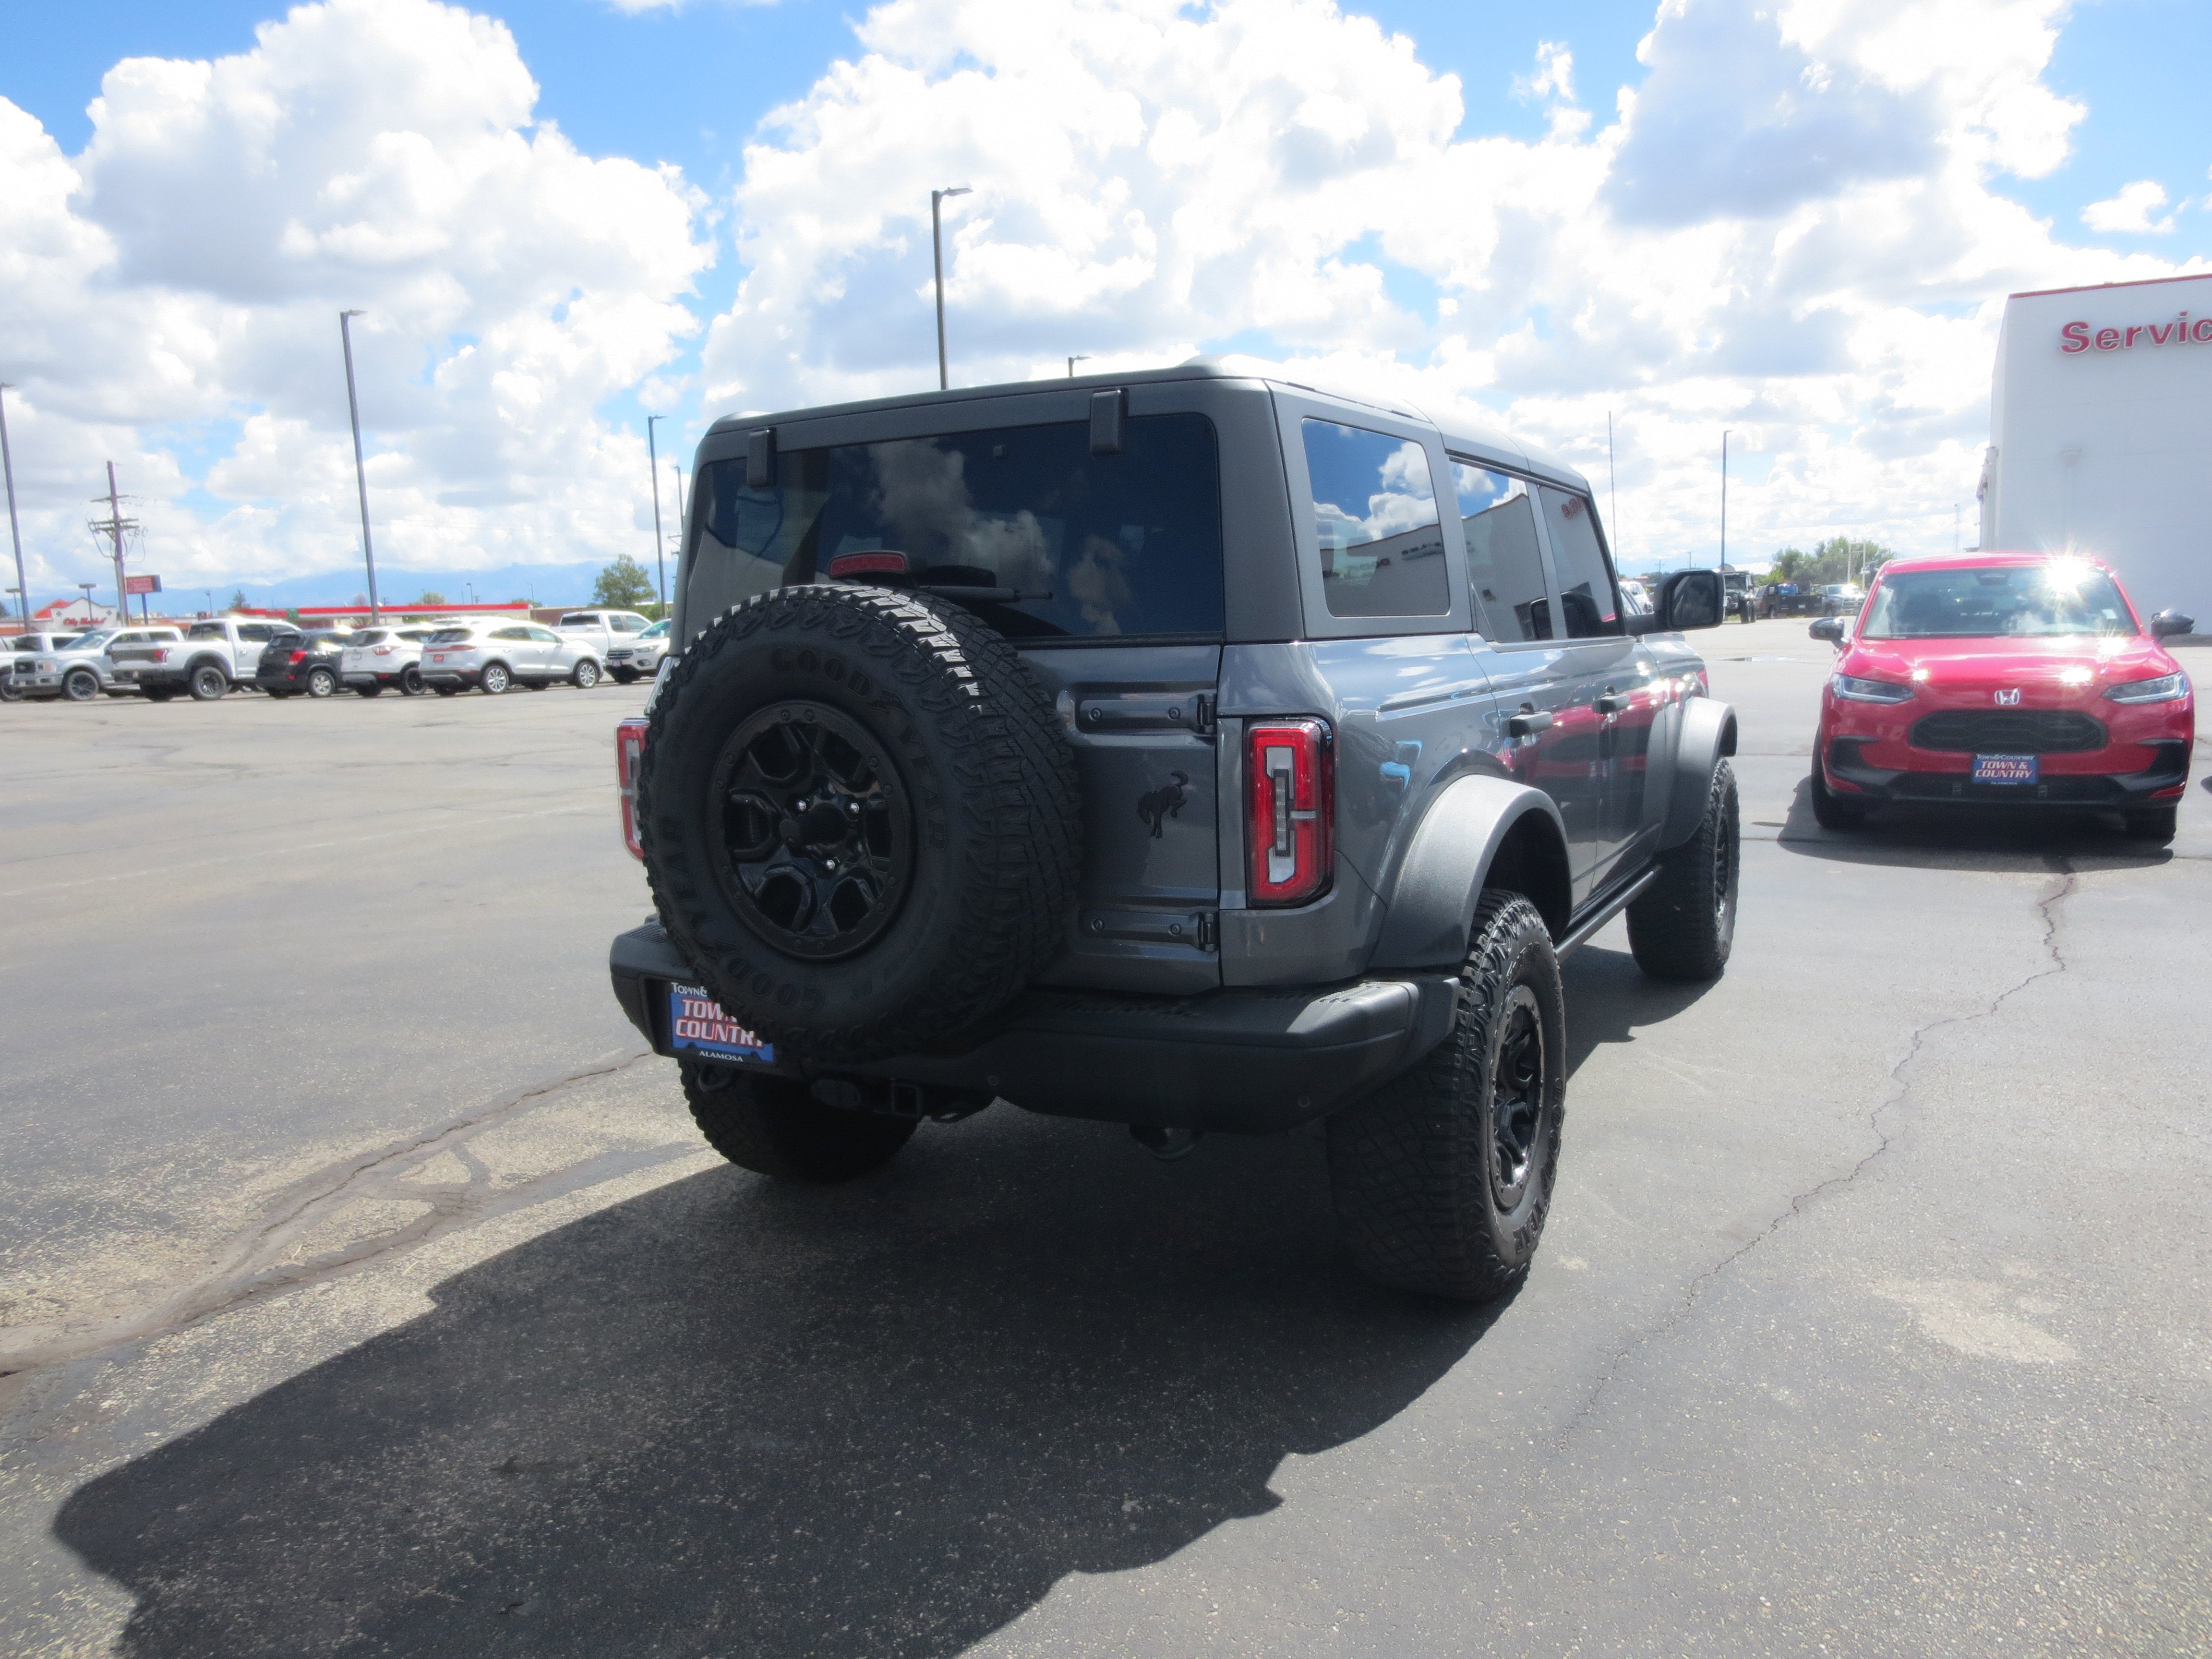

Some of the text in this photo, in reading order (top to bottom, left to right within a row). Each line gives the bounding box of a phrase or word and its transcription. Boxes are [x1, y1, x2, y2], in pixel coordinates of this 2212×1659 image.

[2061, 311, 2212, 354] Servic
[1981, 760, 2029, 769] TOWN &
[1975, 769, 2033, 779] COUNTRY
[682, 999, 738, 1022] TOW
[699, 1050, 744, 1062] ALAMOSA
